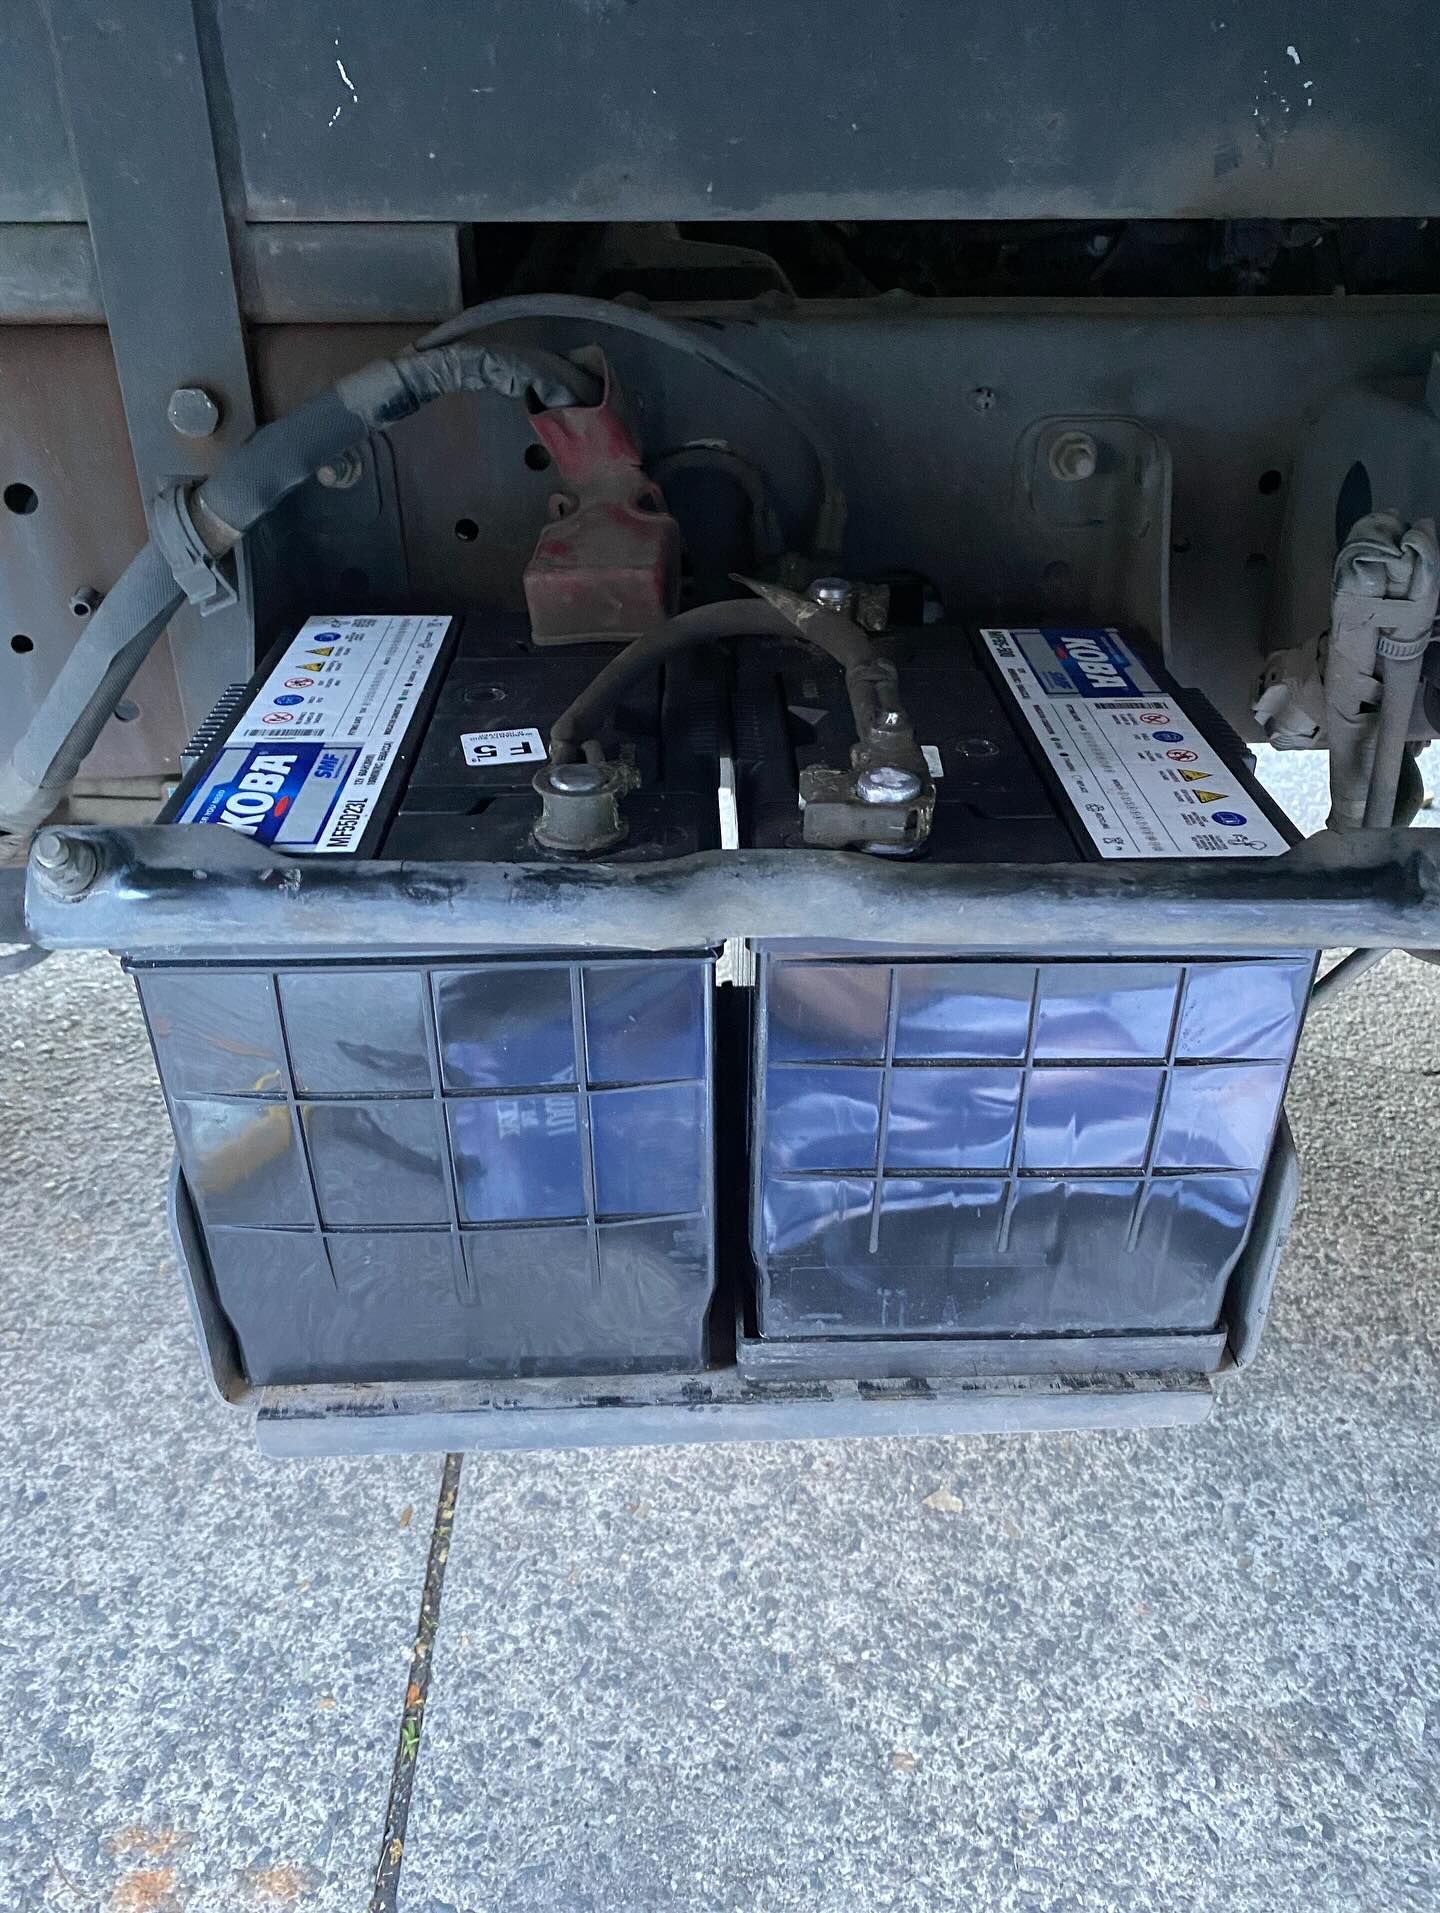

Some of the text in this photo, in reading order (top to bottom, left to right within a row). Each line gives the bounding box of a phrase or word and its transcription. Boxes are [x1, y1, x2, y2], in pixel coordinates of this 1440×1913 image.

[1061, 637, 1128, 687] KOBA
[315, 753, 337, 777] SMF
[510, 742, 532, 755] F
[203, 804, 217, 815] YOU
[217, 755, 298, 834] KOBA
[327, 799, 368, 847] MF55D23L
